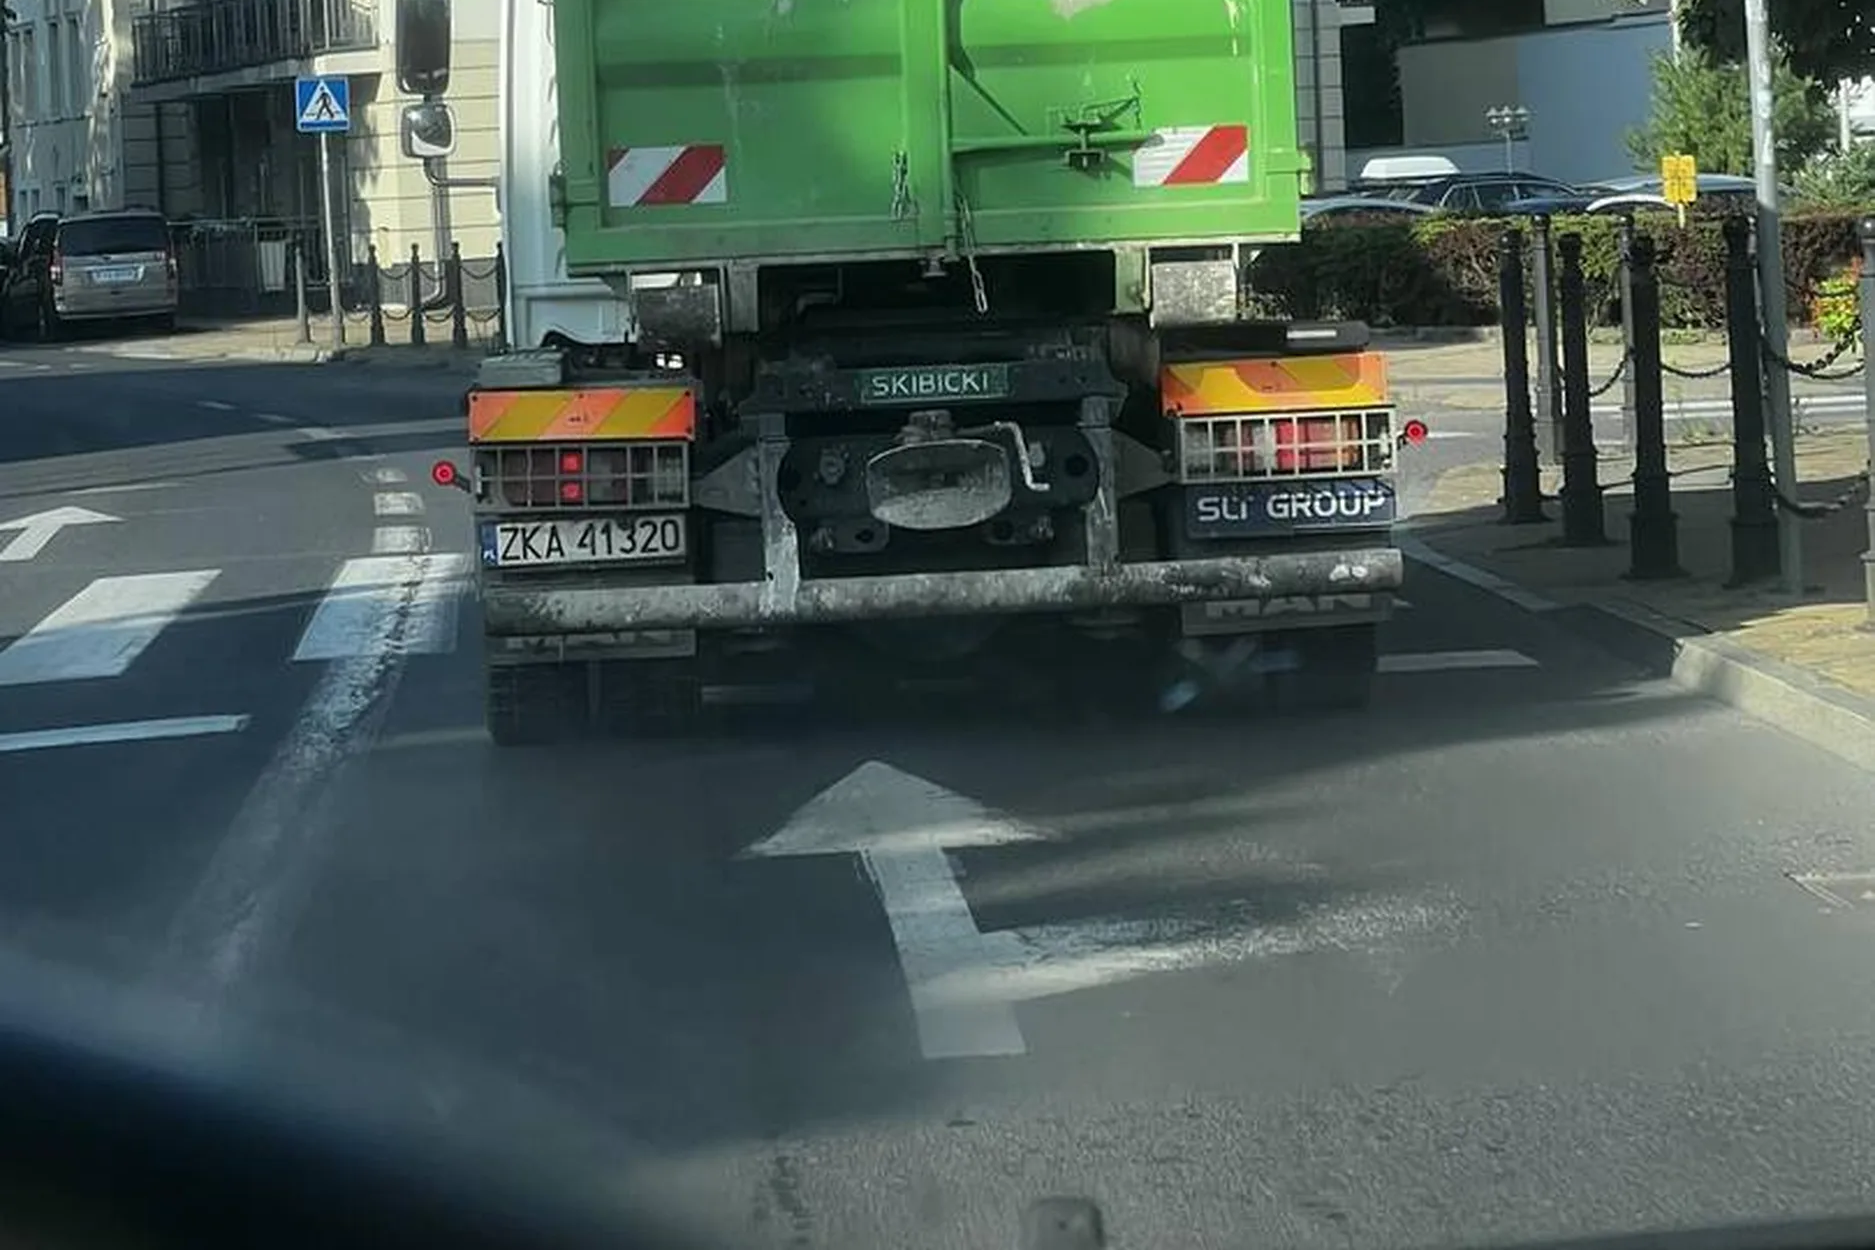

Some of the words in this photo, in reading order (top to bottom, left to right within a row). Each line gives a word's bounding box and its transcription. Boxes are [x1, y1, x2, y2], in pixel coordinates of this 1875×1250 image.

[872, 372, 988, 397] SKIBICKI
[1266, 490, 1385, 519] GROUP
[500, 524, 565, 561] ZKA
[577, 518, 681, 556] 41320
